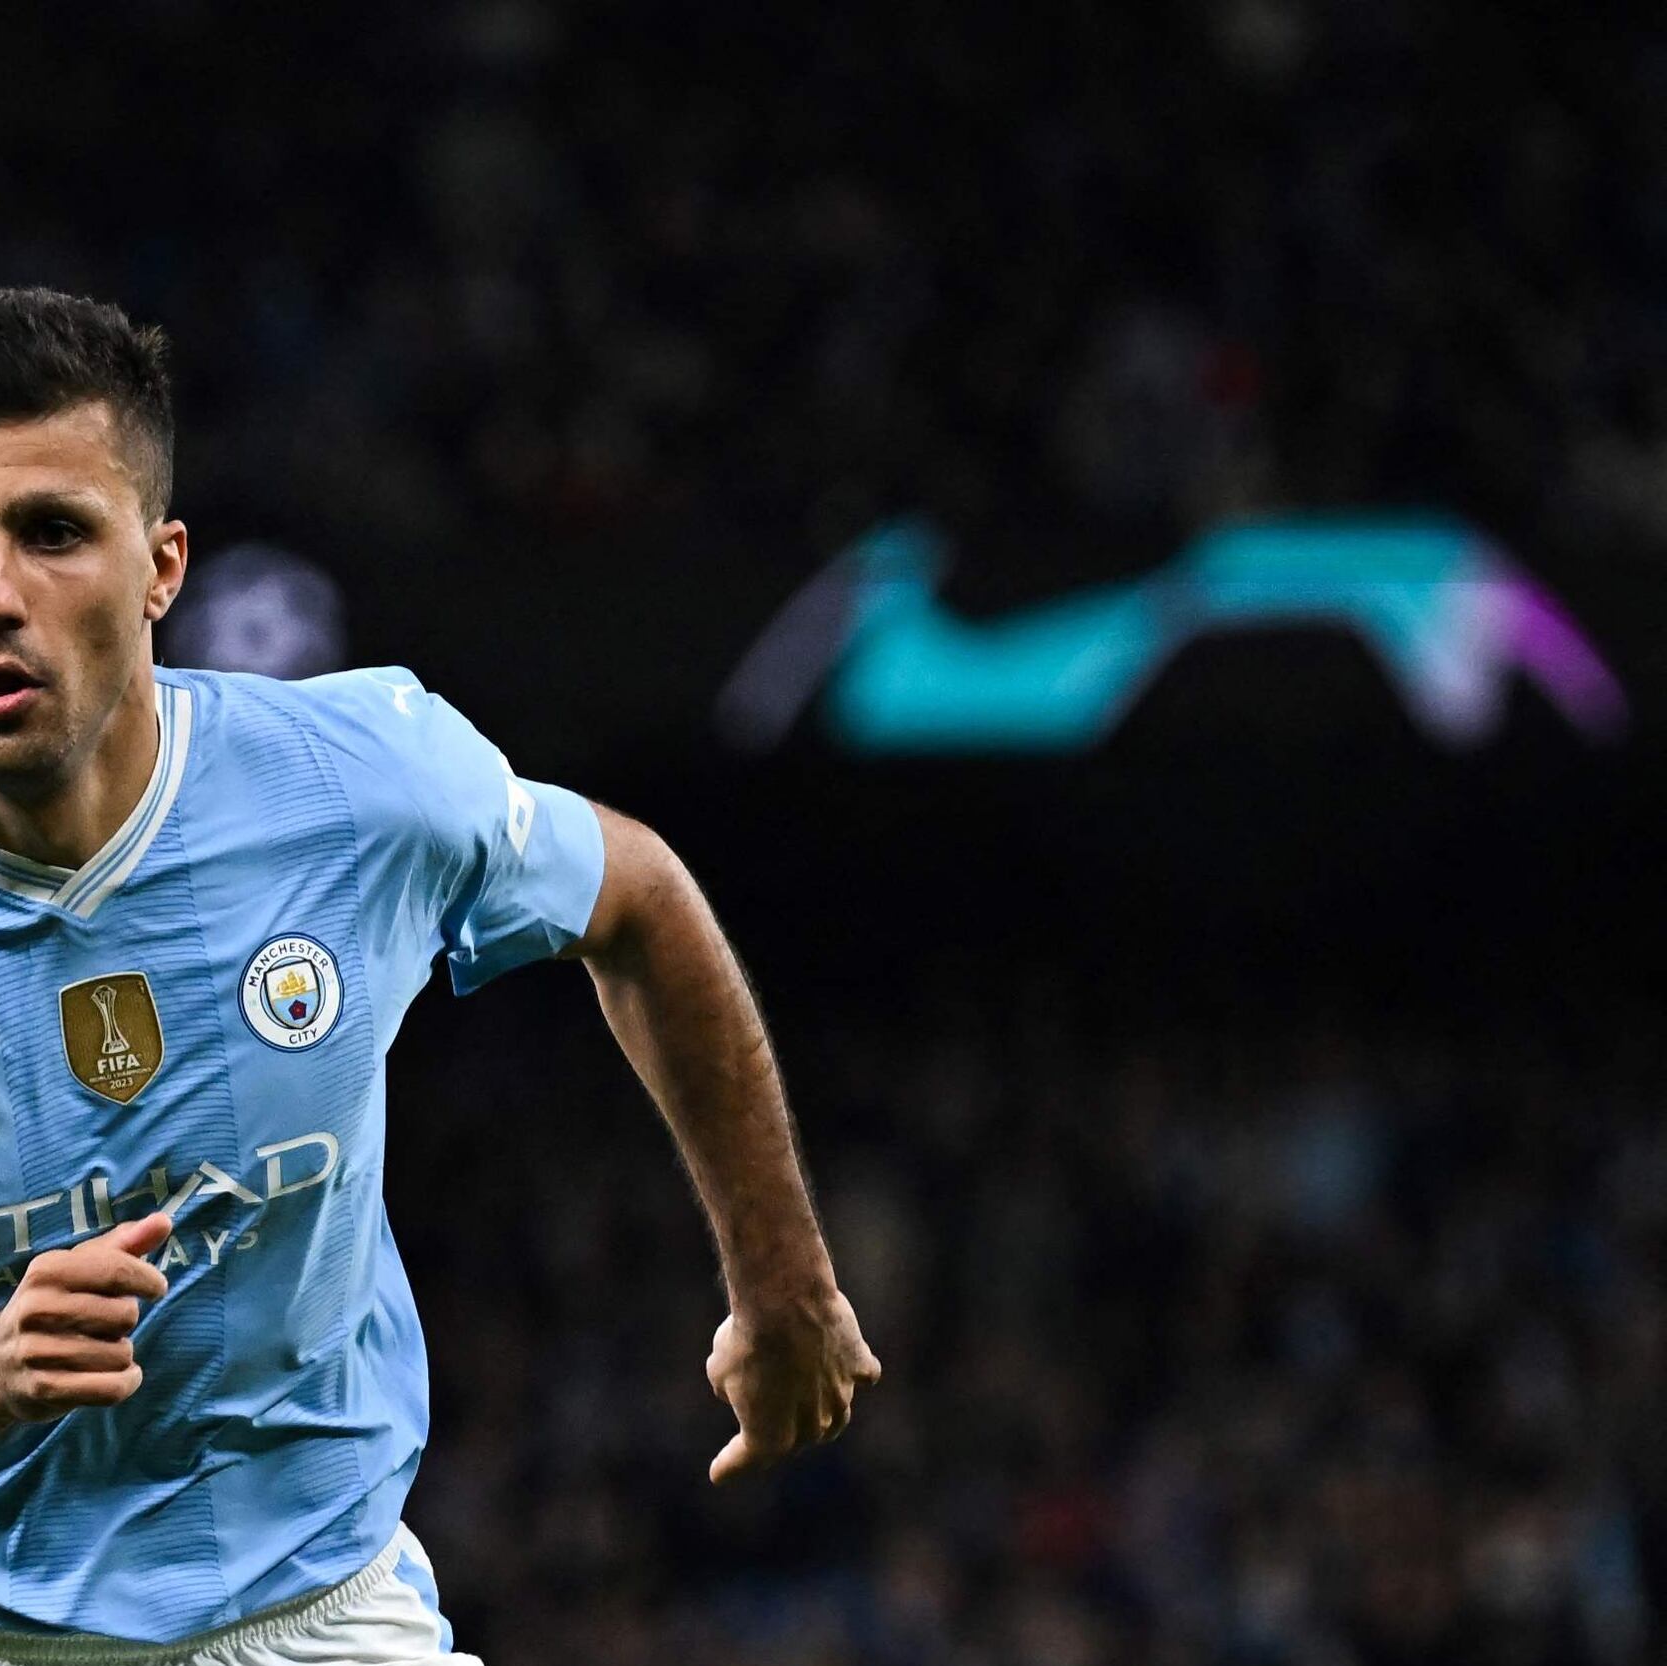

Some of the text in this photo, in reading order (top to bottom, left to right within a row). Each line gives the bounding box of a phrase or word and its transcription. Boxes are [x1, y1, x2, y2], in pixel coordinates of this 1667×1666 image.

[248, 942, 329, 988] MANCHESTER
[289, 1027, 318, 1045] CITY
[97, 1053, 141, 1075] FIFA
[109, 1077, 134, 1089] 2023
